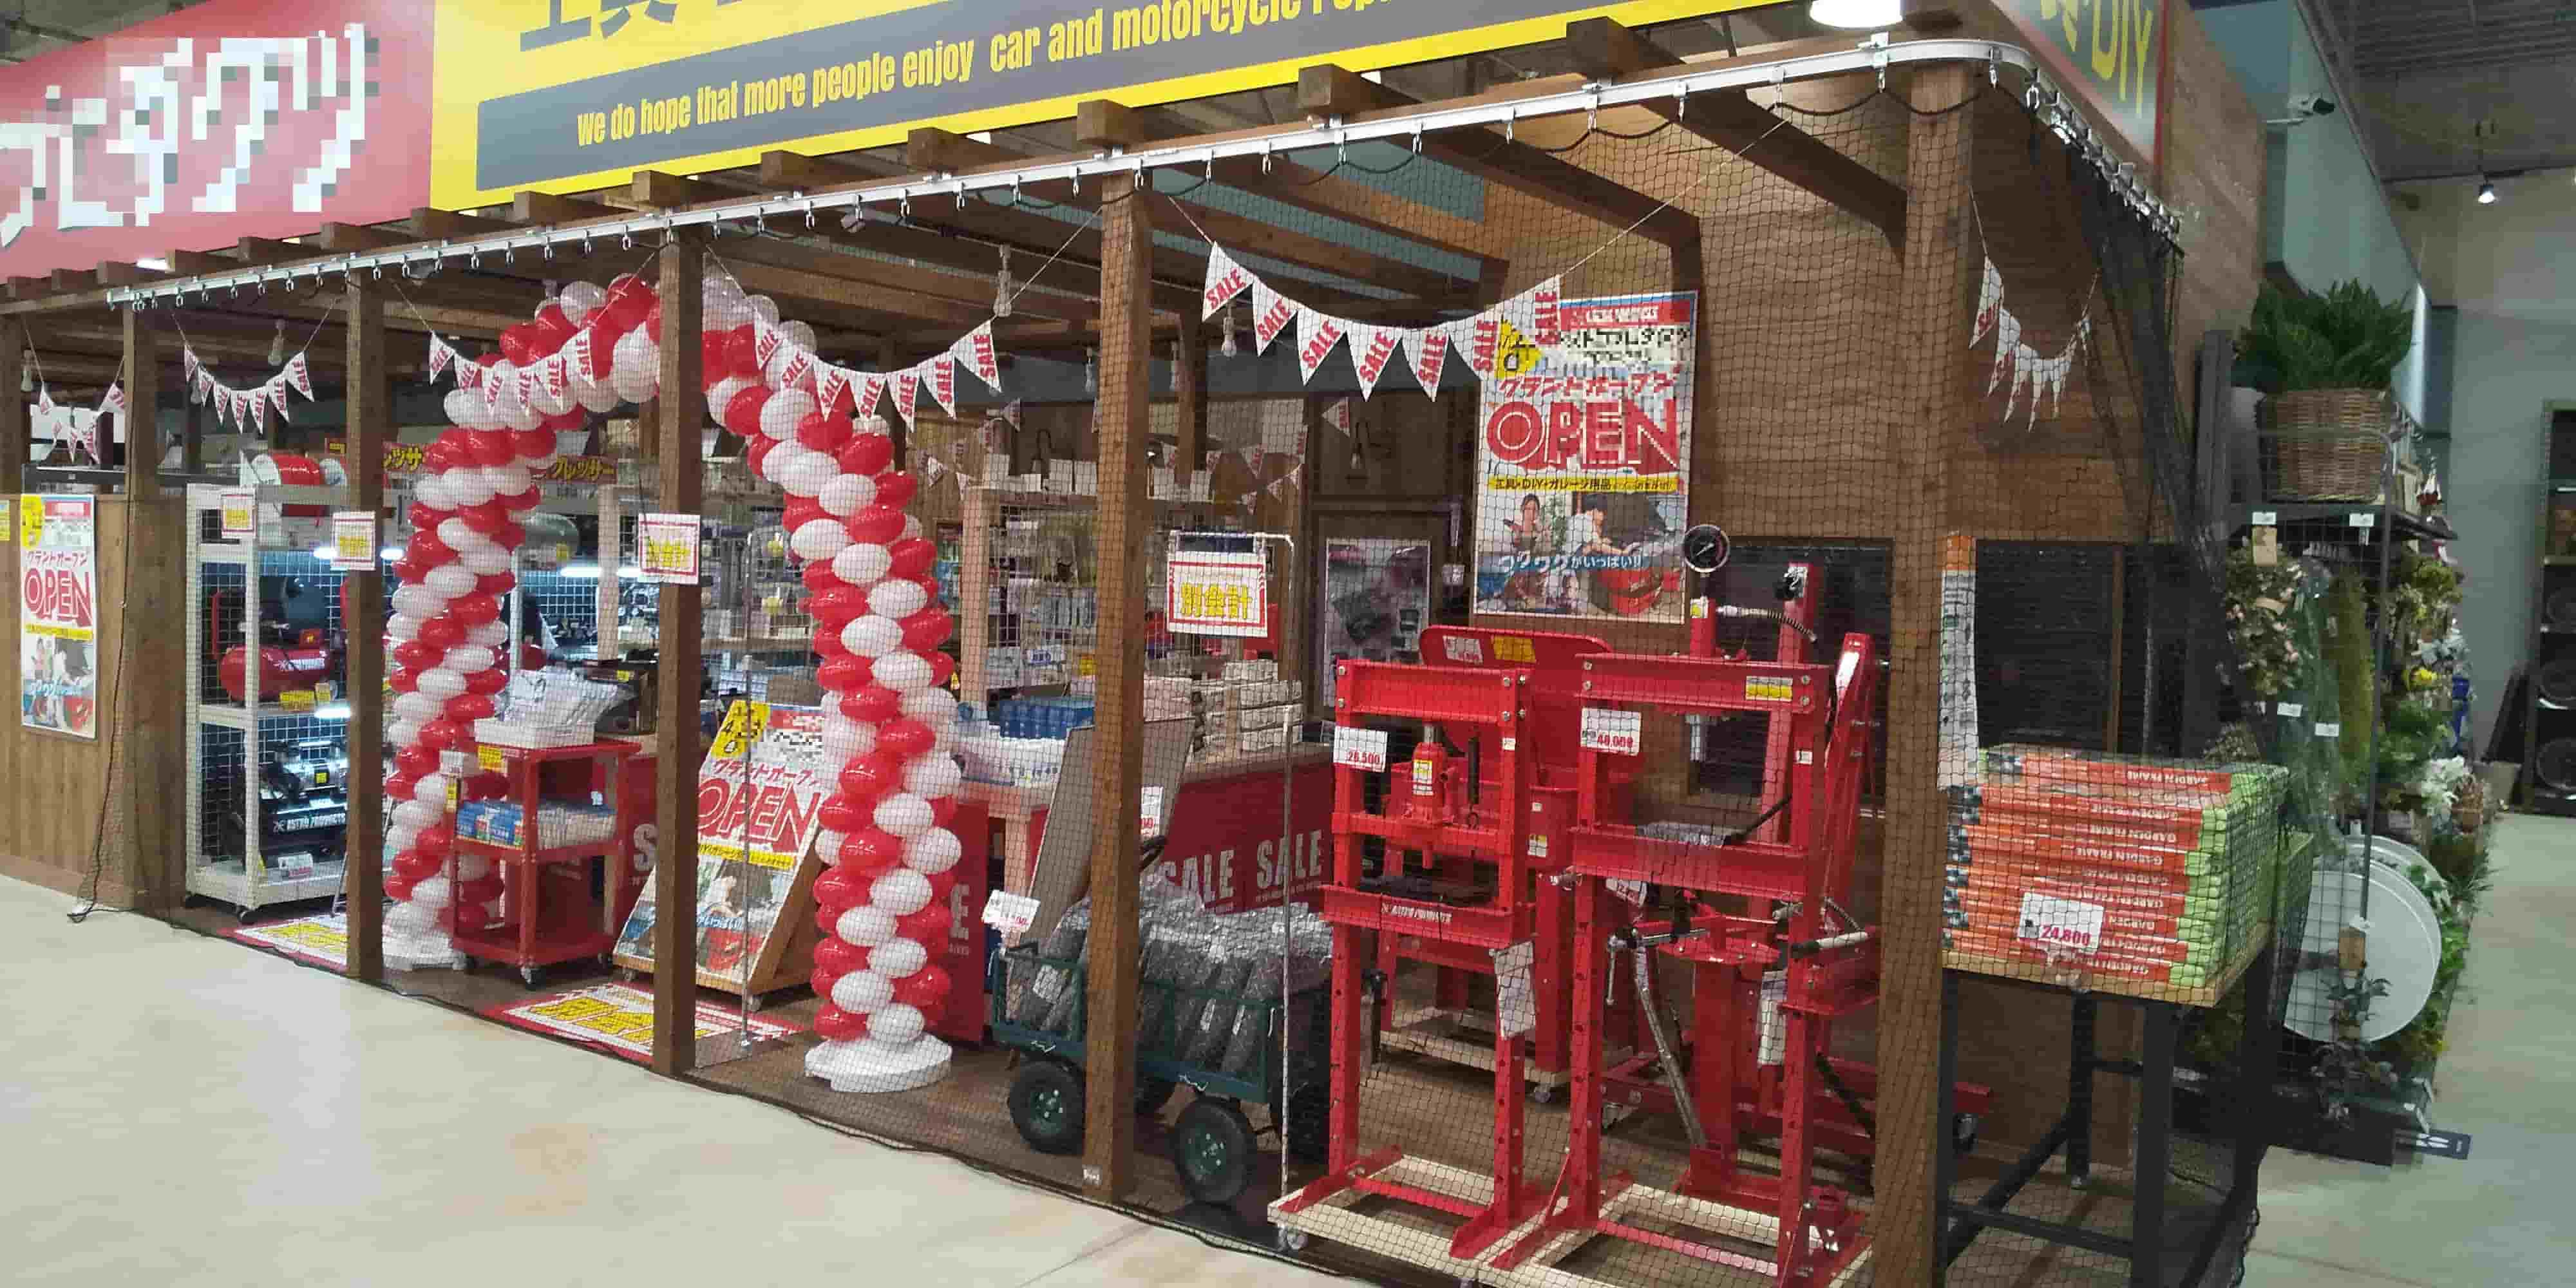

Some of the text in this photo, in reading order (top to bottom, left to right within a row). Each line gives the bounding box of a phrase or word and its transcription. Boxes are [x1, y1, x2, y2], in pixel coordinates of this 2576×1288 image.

[611, 103, 634, 140] do
[639, 95, 692, 136] hope
[696, 80, 737, 125] that
[744, 72, 806, 115] more
[812, 52, 895, 109] people
[902, 40, 974, 89] enjoy
[989, 26, 1041, 73] car
[1047, 9, 1103, 62] and
[1206, 269, 1246, 309] SALE
[1258, 299, 1291, 341] SALE
[576, 339, 592, 377] SALE
[758, 329, 779, 359] SALE
[972, 334, 996, 378] SALE
[1302, 321, 1341, 369] SALE
[1359, 332, 1395, 382] SALE
[1419, 330, 1447, 386] SALE
[1473, 320, 1498, 372] SALE
[486, 375, 504, 404] SALE
[519, 371, 533, 406] SALE
[548, 360, 562, 399] SALE
[782, 350, 808, 388] SALE
[821, 370, 844, 408] SALE
[934, 360, 952, 403] SALE
[860, 377, 882, 418] SALE
[899, 374, 918, 417] SALE
[1486, 399, 1679, 475] OPEN
[24, 568, 93, 627] OPEN
[1256, 829, 1322, 889] SALE
